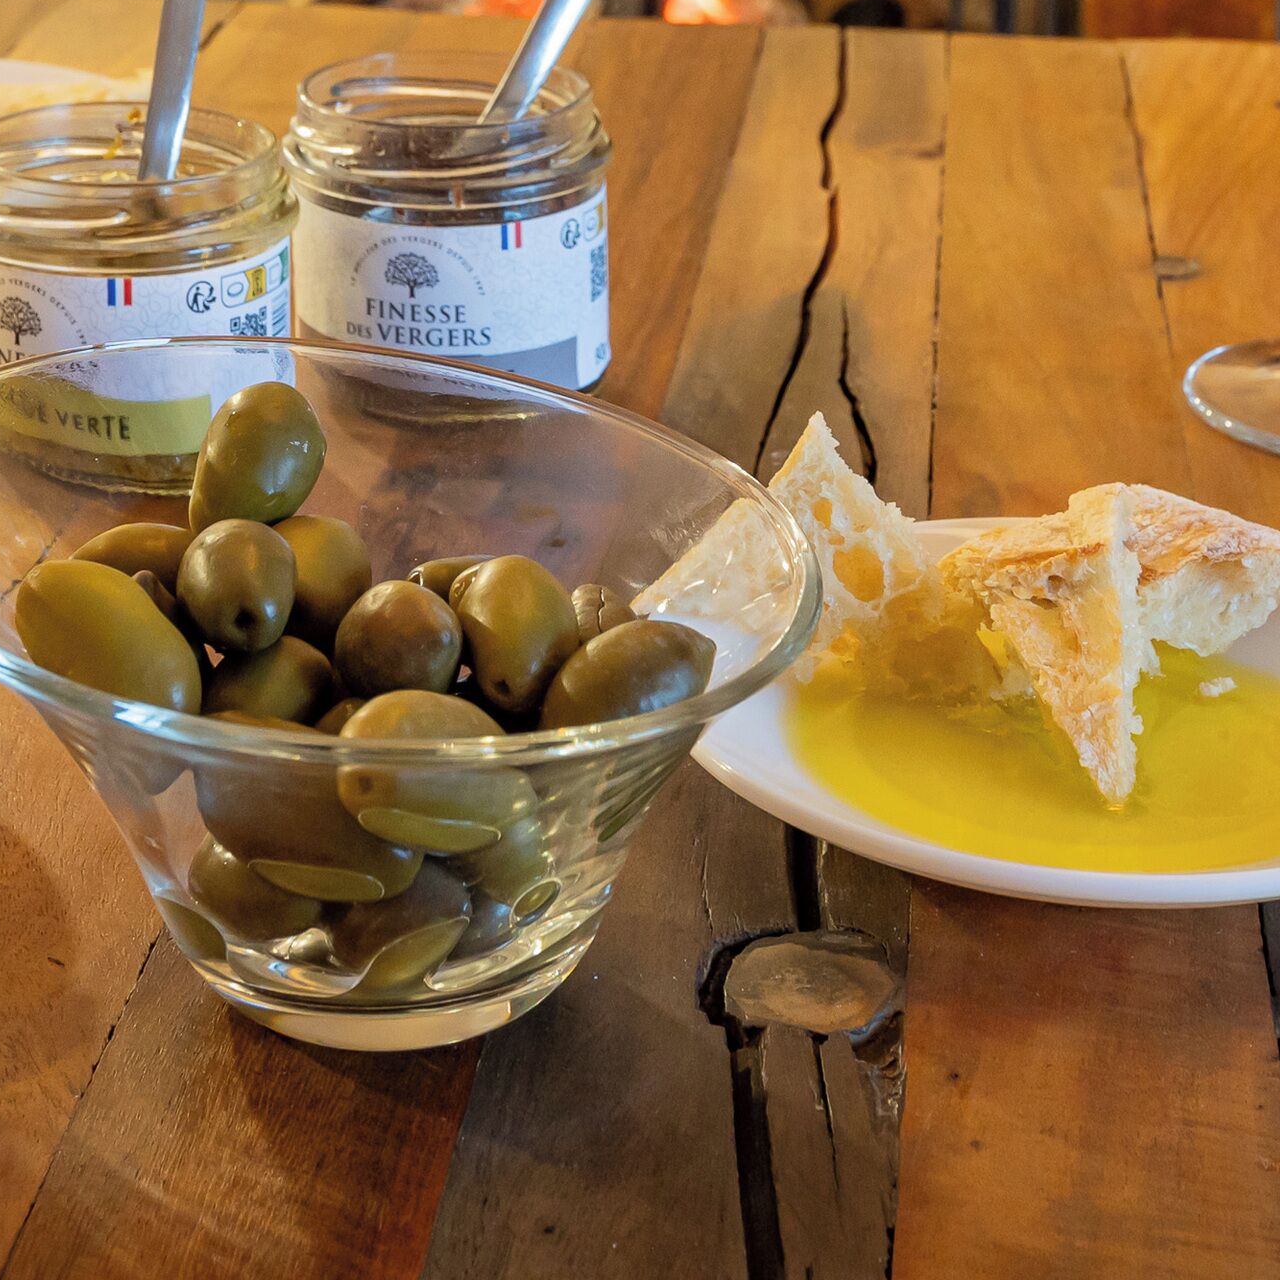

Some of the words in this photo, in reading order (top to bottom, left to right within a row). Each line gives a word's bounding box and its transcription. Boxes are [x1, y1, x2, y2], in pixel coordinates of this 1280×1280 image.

[365, 297, 467, 324] FINESSE
[346, 320, 373, 339] DES
[377, 323, 492, 347] VERGERS
[55, 407, 131, 441] VERTE
